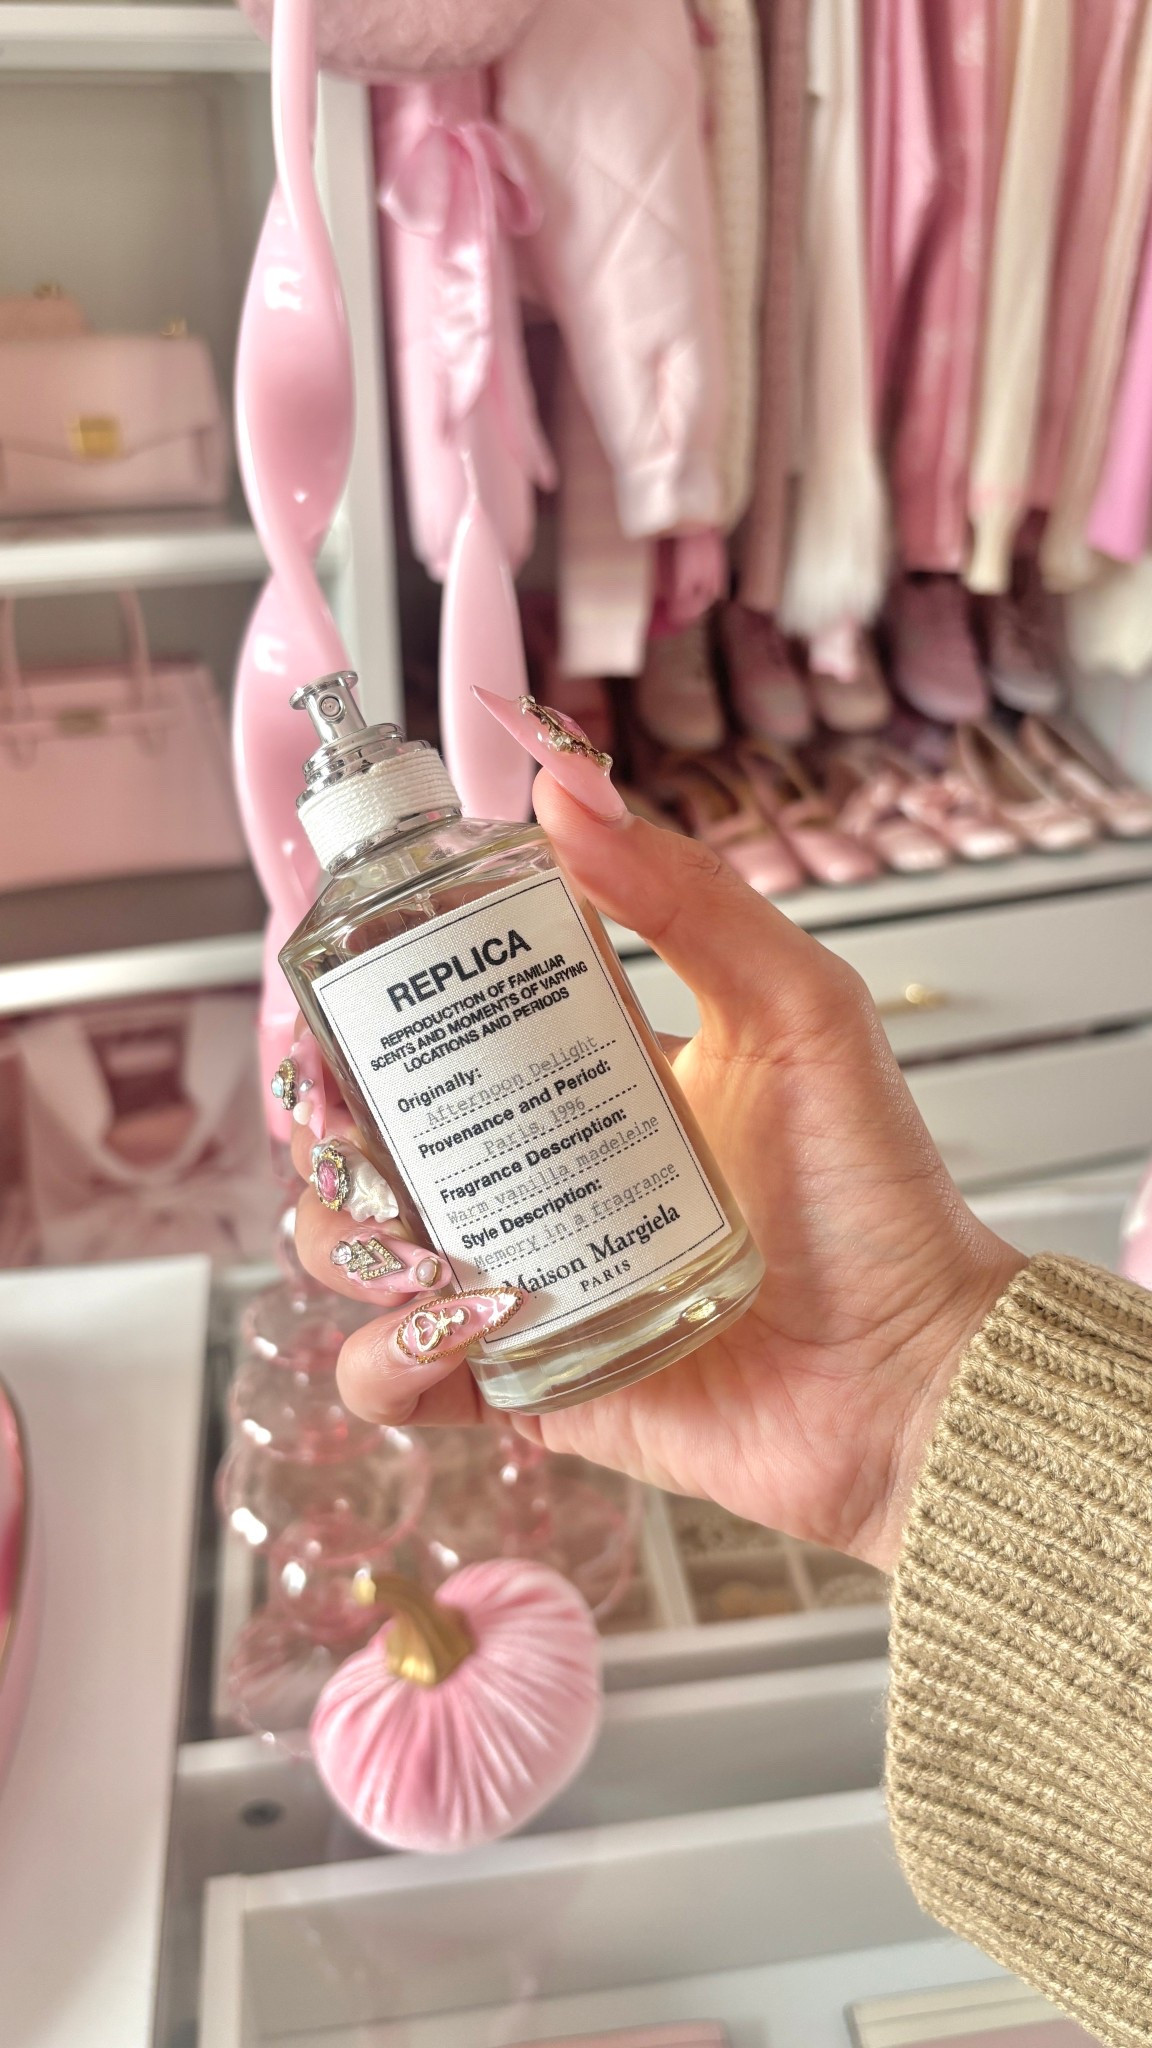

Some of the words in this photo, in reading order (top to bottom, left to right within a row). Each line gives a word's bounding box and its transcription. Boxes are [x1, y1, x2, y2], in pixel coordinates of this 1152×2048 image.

[380, 990, 485, 1049] REPRODUCTION
[487, 980, 506, 997] OF
[509, 954, 566, 989] FAMILIAR
[386, 929, 532, 1012] REPLICA
[370, 1042, 416, 1071] SCENTS
[418, 1027, 447, 1050] AND
[449, 992, 520, 1034] MOMENTS
[521, 983, 539, 1000] OF
[540, 961, 588, 990] VARYING
[404, 1030, 480, 1073] LOCATIONS
[482, 1014, 512, 1037] AND
[513, 986, 570, 1021] PERIODS
[397, 1067, 482, 1113] Originally:
[418, 1108, 515, 1159] Provenance
[518, 1088, 553, 1114] and
[553, 1059, 611, 1097] Period:
[426, 1073, 525, 1125] Afternoon
[528, 1035, 598, 1077] Delight
[440, 1161, 523, 1204] Fragrance
[525, 1108, 627, 1166] Description:
[483, 1119, 547, 1156] Paris,
[551, 1096, 586, 1123] 1996
[446, 1202, 490, 1225] Warm
[494, 1164, 570, 1205] vanilla
[575, 1116, 659, 1168] madeleine
[461, 1225, 498, 1249] Style
[500, 1179, 602, 1233] Description:
[474, 1234, 536, 1268] Memory
[547, 1221, 567, 1240] in
[573, 1212, 585, 1225] a
[590, 1162, 676, 1216] fragrance
[587, 1204, 681, 1263] Margiela
[580, 1259, 631, 1293] PARIS
